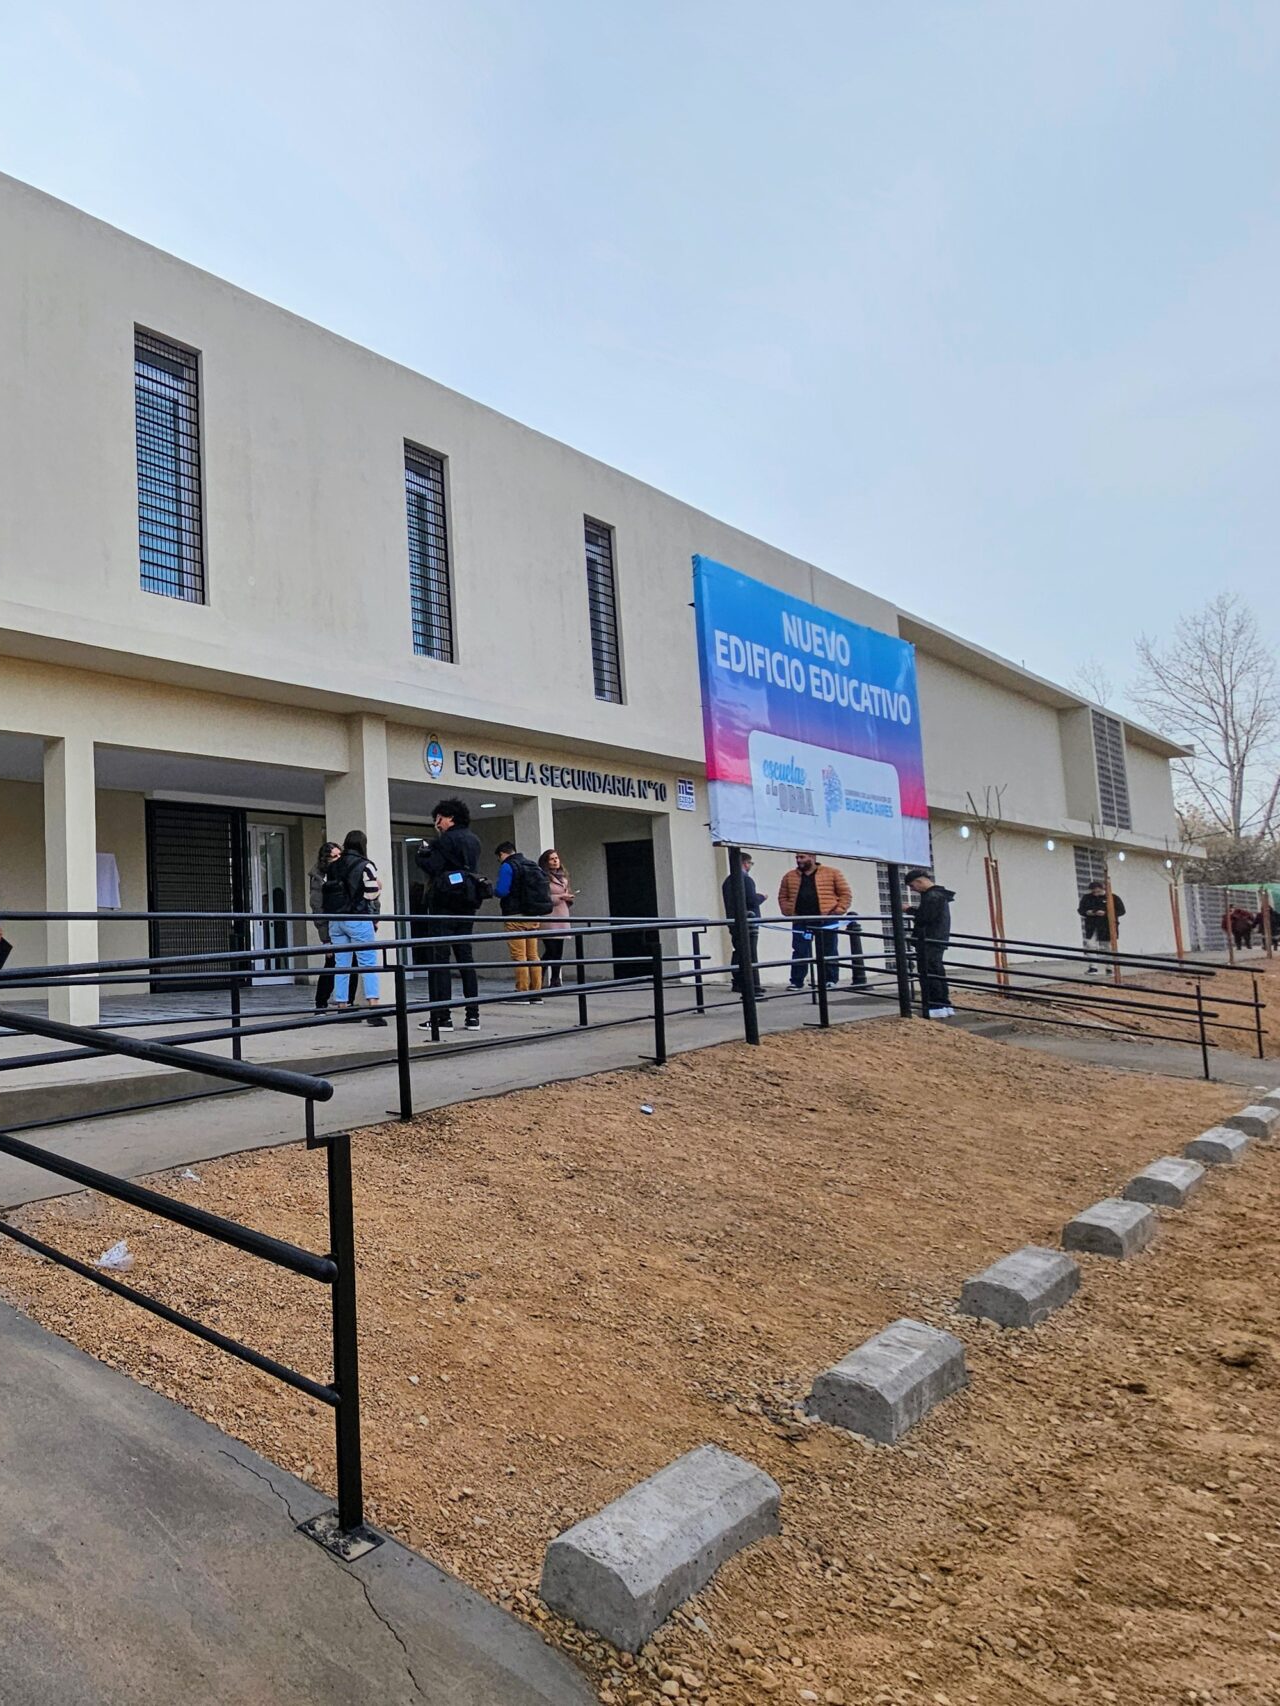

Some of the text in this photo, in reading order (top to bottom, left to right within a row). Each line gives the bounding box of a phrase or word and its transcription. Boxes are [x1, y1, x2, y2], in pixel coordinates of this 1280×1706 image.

[781, 611, 850, 667] NUEVO
[714, 629, 911, 726] EDIFICIO EDUCATIVO
[454, 750, 538, 785] ESCUELA
[539, 763, 636, 798] SECUNDARIA
[763, 755, 806, 786] escuelas
[777, 783, 817, 817] OBRA
[845, 797, 894, 818] BUENOS AIRES
